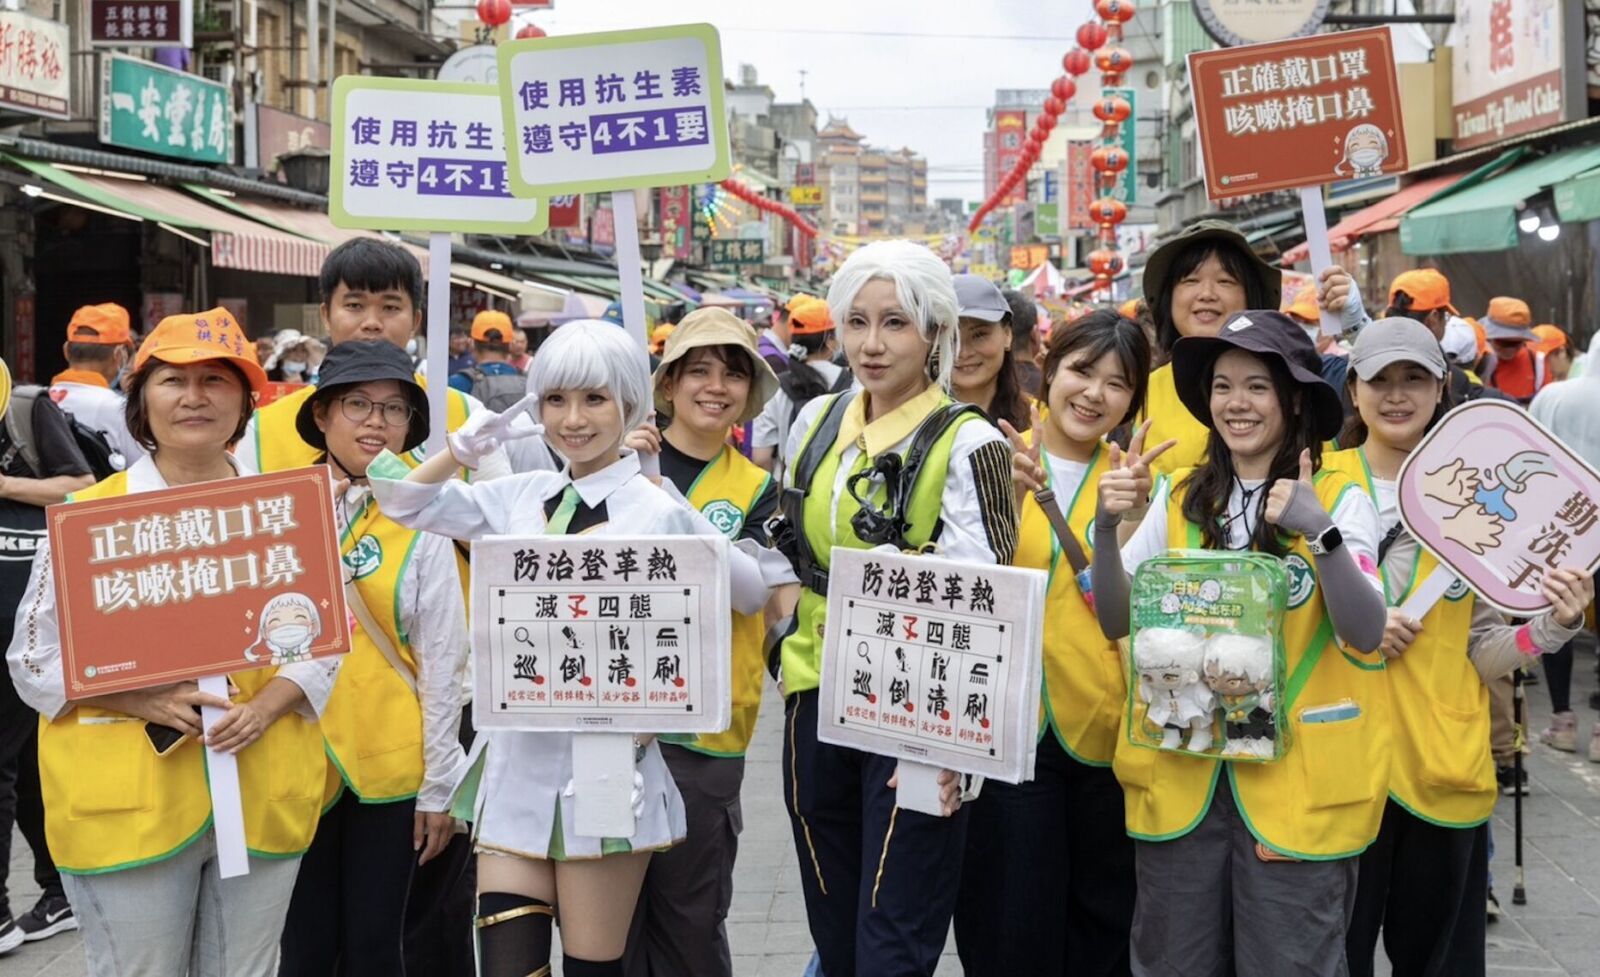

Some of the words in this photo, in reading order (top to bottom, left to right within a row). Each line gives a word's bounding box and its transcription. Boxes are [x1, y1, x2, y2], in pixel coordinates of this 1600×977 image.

[518, 66, 702, 111] 使用抗生素
[1220, 49, 1370, 98] 正確戴口罩
[1225, 87, 1375, 135] 咳嗽掩口鼻
[1534, 83, 1560, 115] Cake
[351, 116, 508, 151] 使用抗生
[523, 109, 706, 154] 遵守4不1要
[90, 495, 296, 562] 正確戴口罩
[1506, 491, 1599, 591] 勤洗手
[94, 545, 303, 612] 咳嗽掩口鼻
[513, 547, 677, 582] 防治登革熱
[861, 561, 995, 615] 防治登革熱
[514, 654, 537, 681] 巡
[560, 654, 586, 684] 倒
[608, 654, 635, 685] 清
[652, 655, 680, 686] 刷
[852, 669, 872, 698] 巡
[889, 677, 910, 707] 倒
[927, 685, 948, 716] 清
[964, 693, 988, 724] 刷
